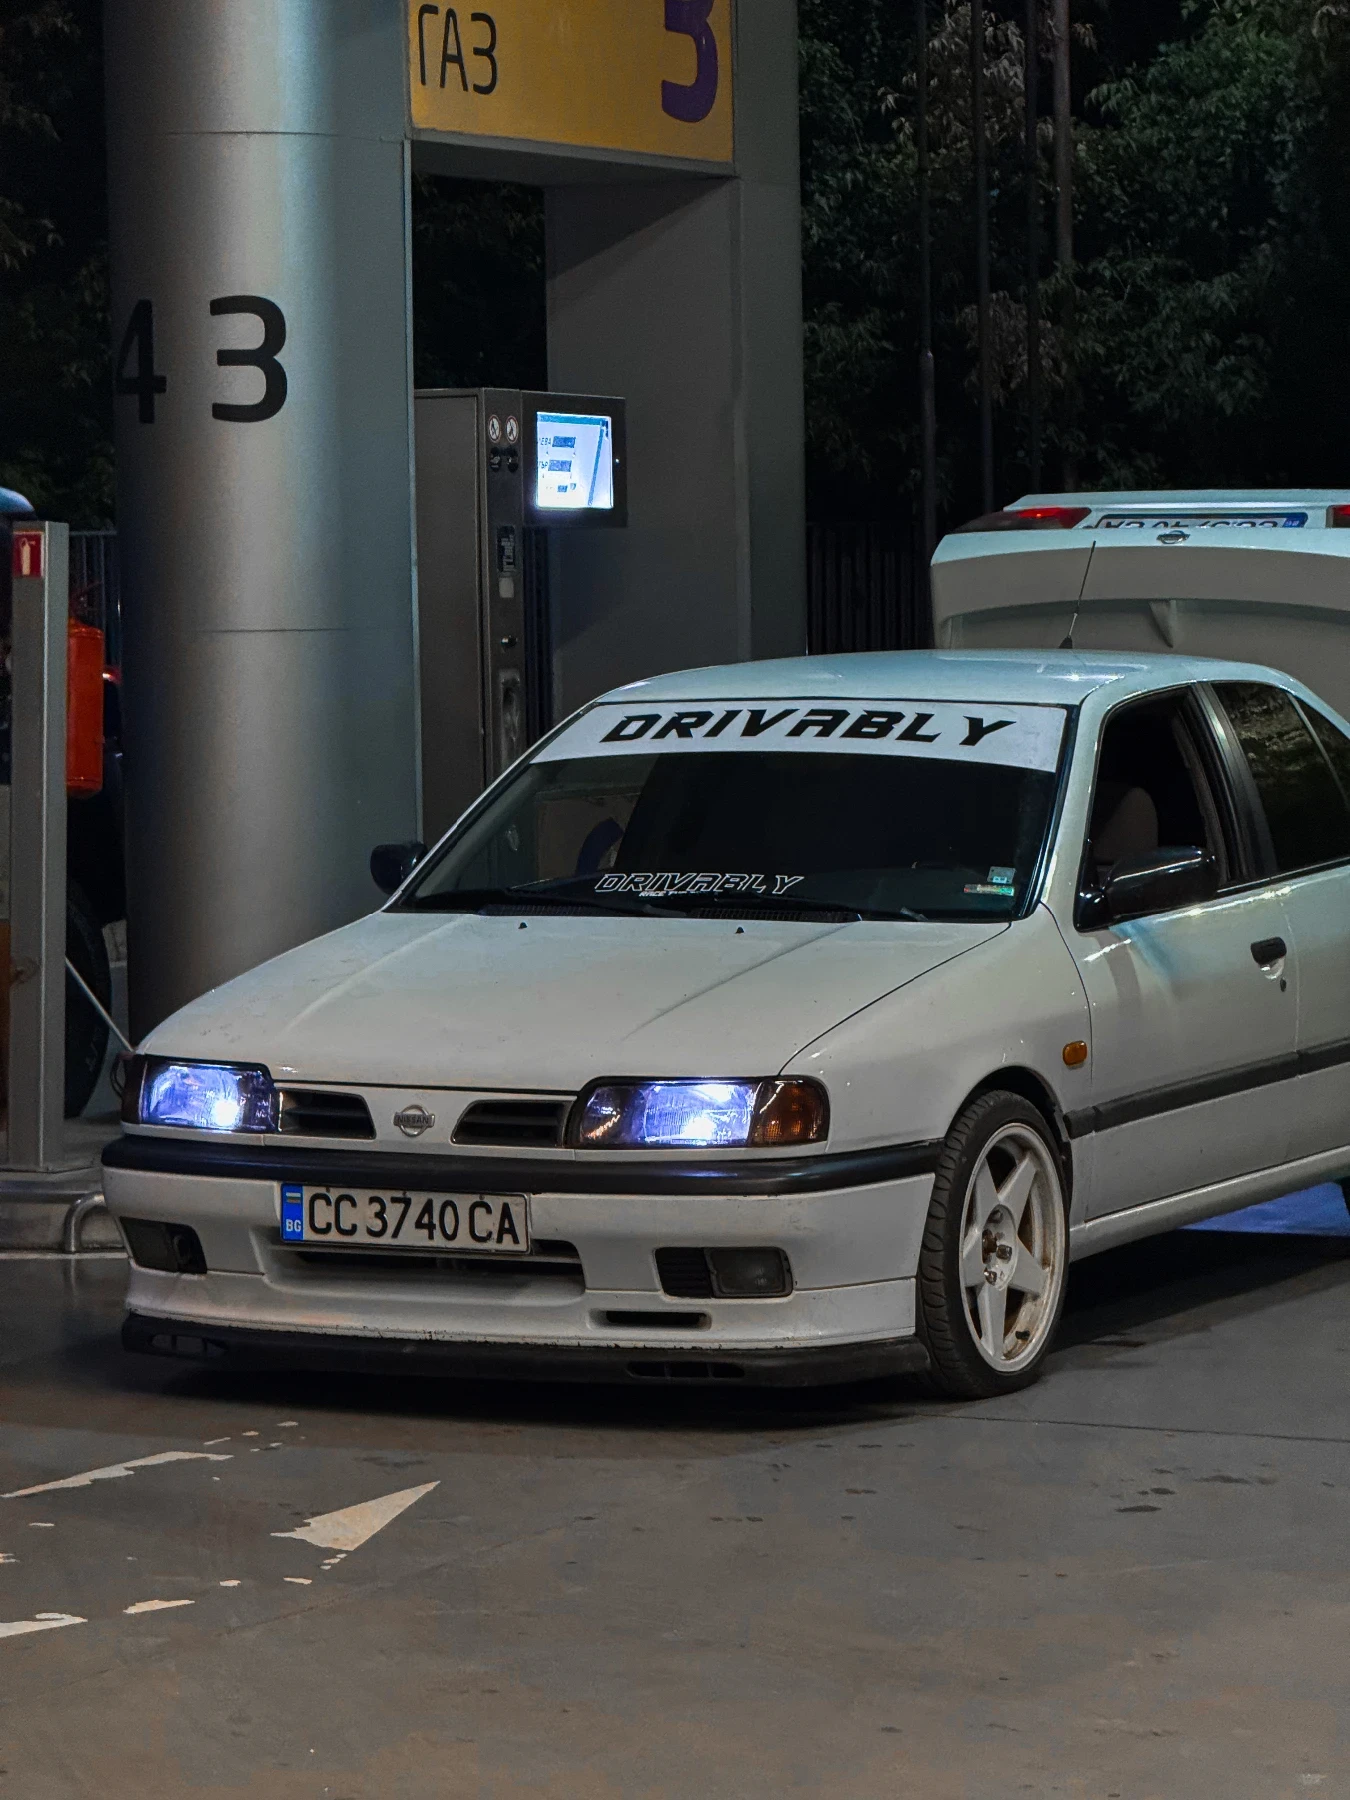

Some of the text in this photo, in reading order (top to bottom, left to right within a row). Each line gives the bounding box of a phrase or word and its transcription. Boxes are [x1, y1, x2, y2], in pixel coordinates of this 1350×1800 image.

[417, 3, 498, 95] ГАЗ
[661, 0, 719, 123] 3
[116, 295, 288, 424] 4 3
[600, 708, 1016, 747] DRIVABLY
[594, 873, 805, 894] DRIVABLY
[397, 1114, 430, 1125] NISSAN
[285, 1218, 303, 1233] BG
[366, 1196, 460, 1242] 3740
[468, 1200, 520, 1245] CA
